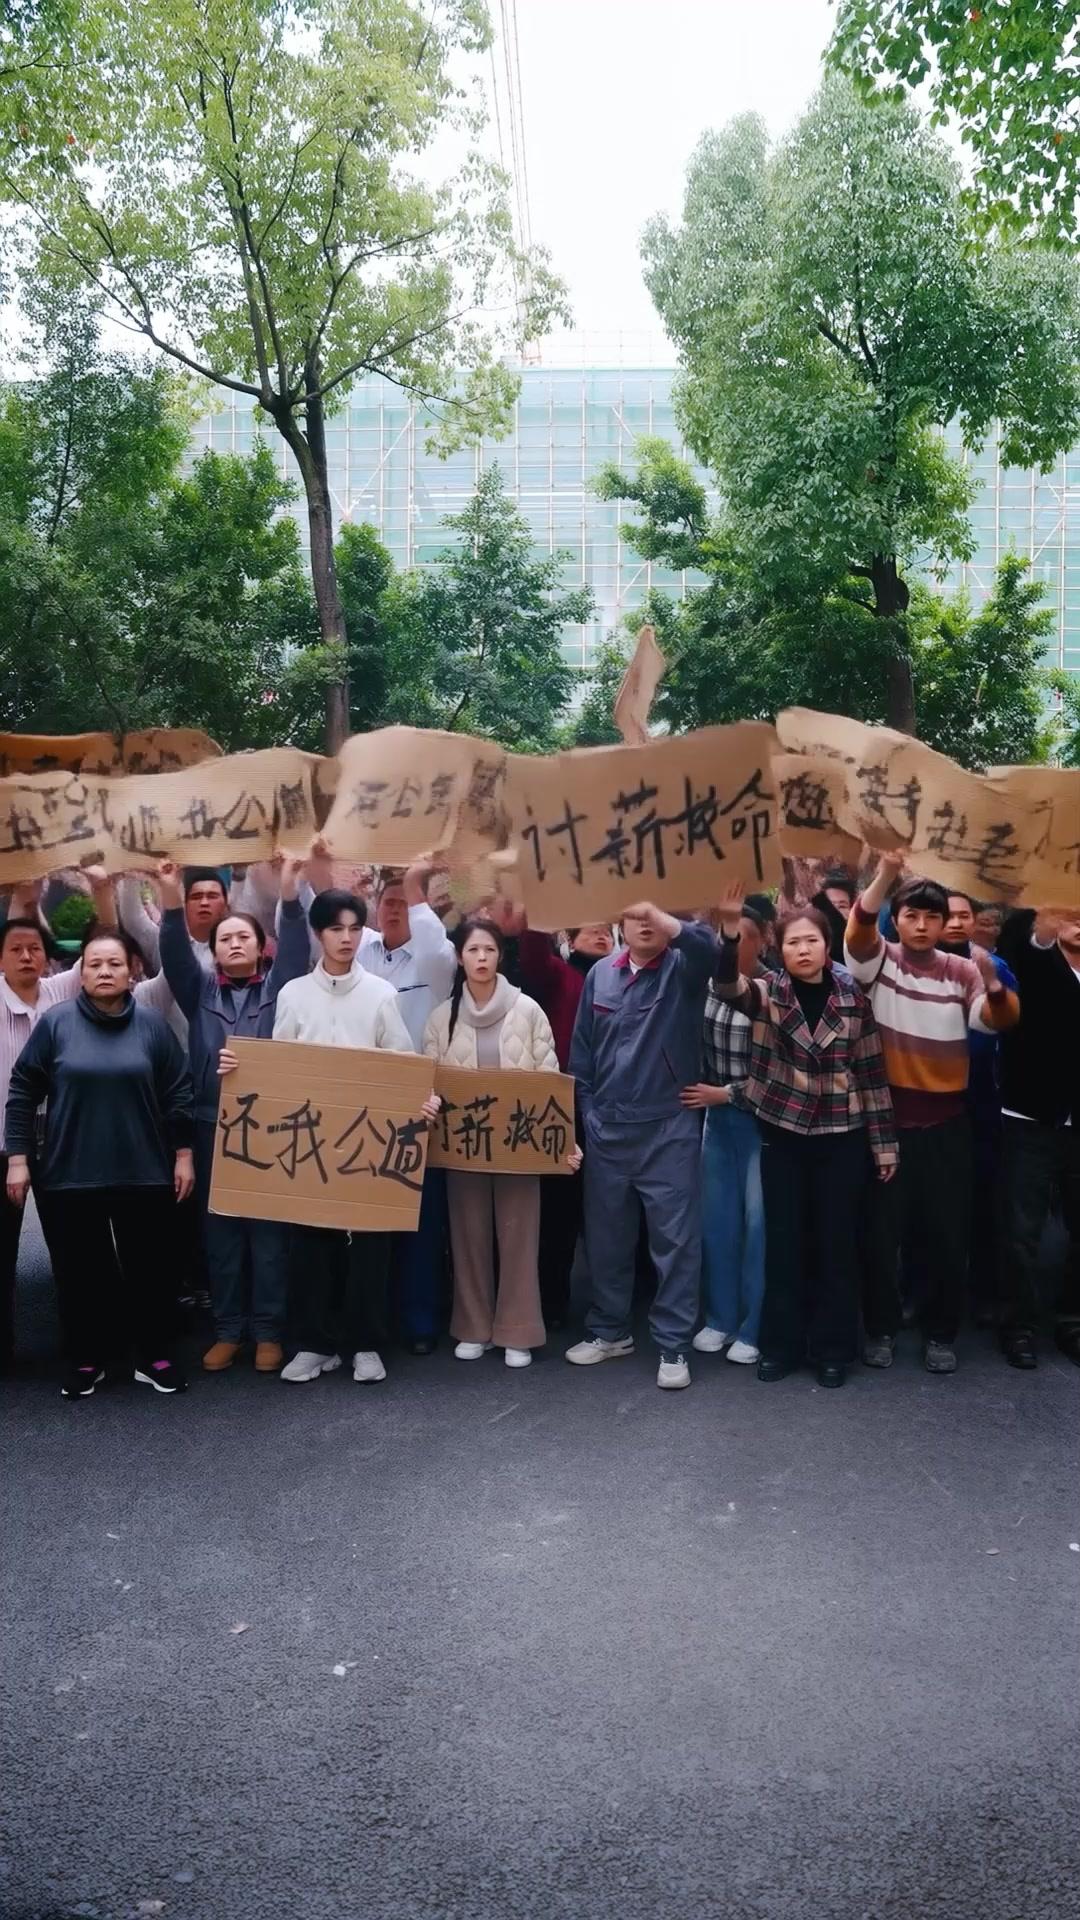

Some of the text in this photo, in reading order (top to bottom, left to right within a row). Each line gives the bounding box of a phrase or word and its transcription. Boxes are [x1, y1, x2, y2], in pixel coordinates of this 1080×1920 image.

[521, 768, 776, 885] 讨薪救命
[218, 1092, 428, 1192] 还我公道
